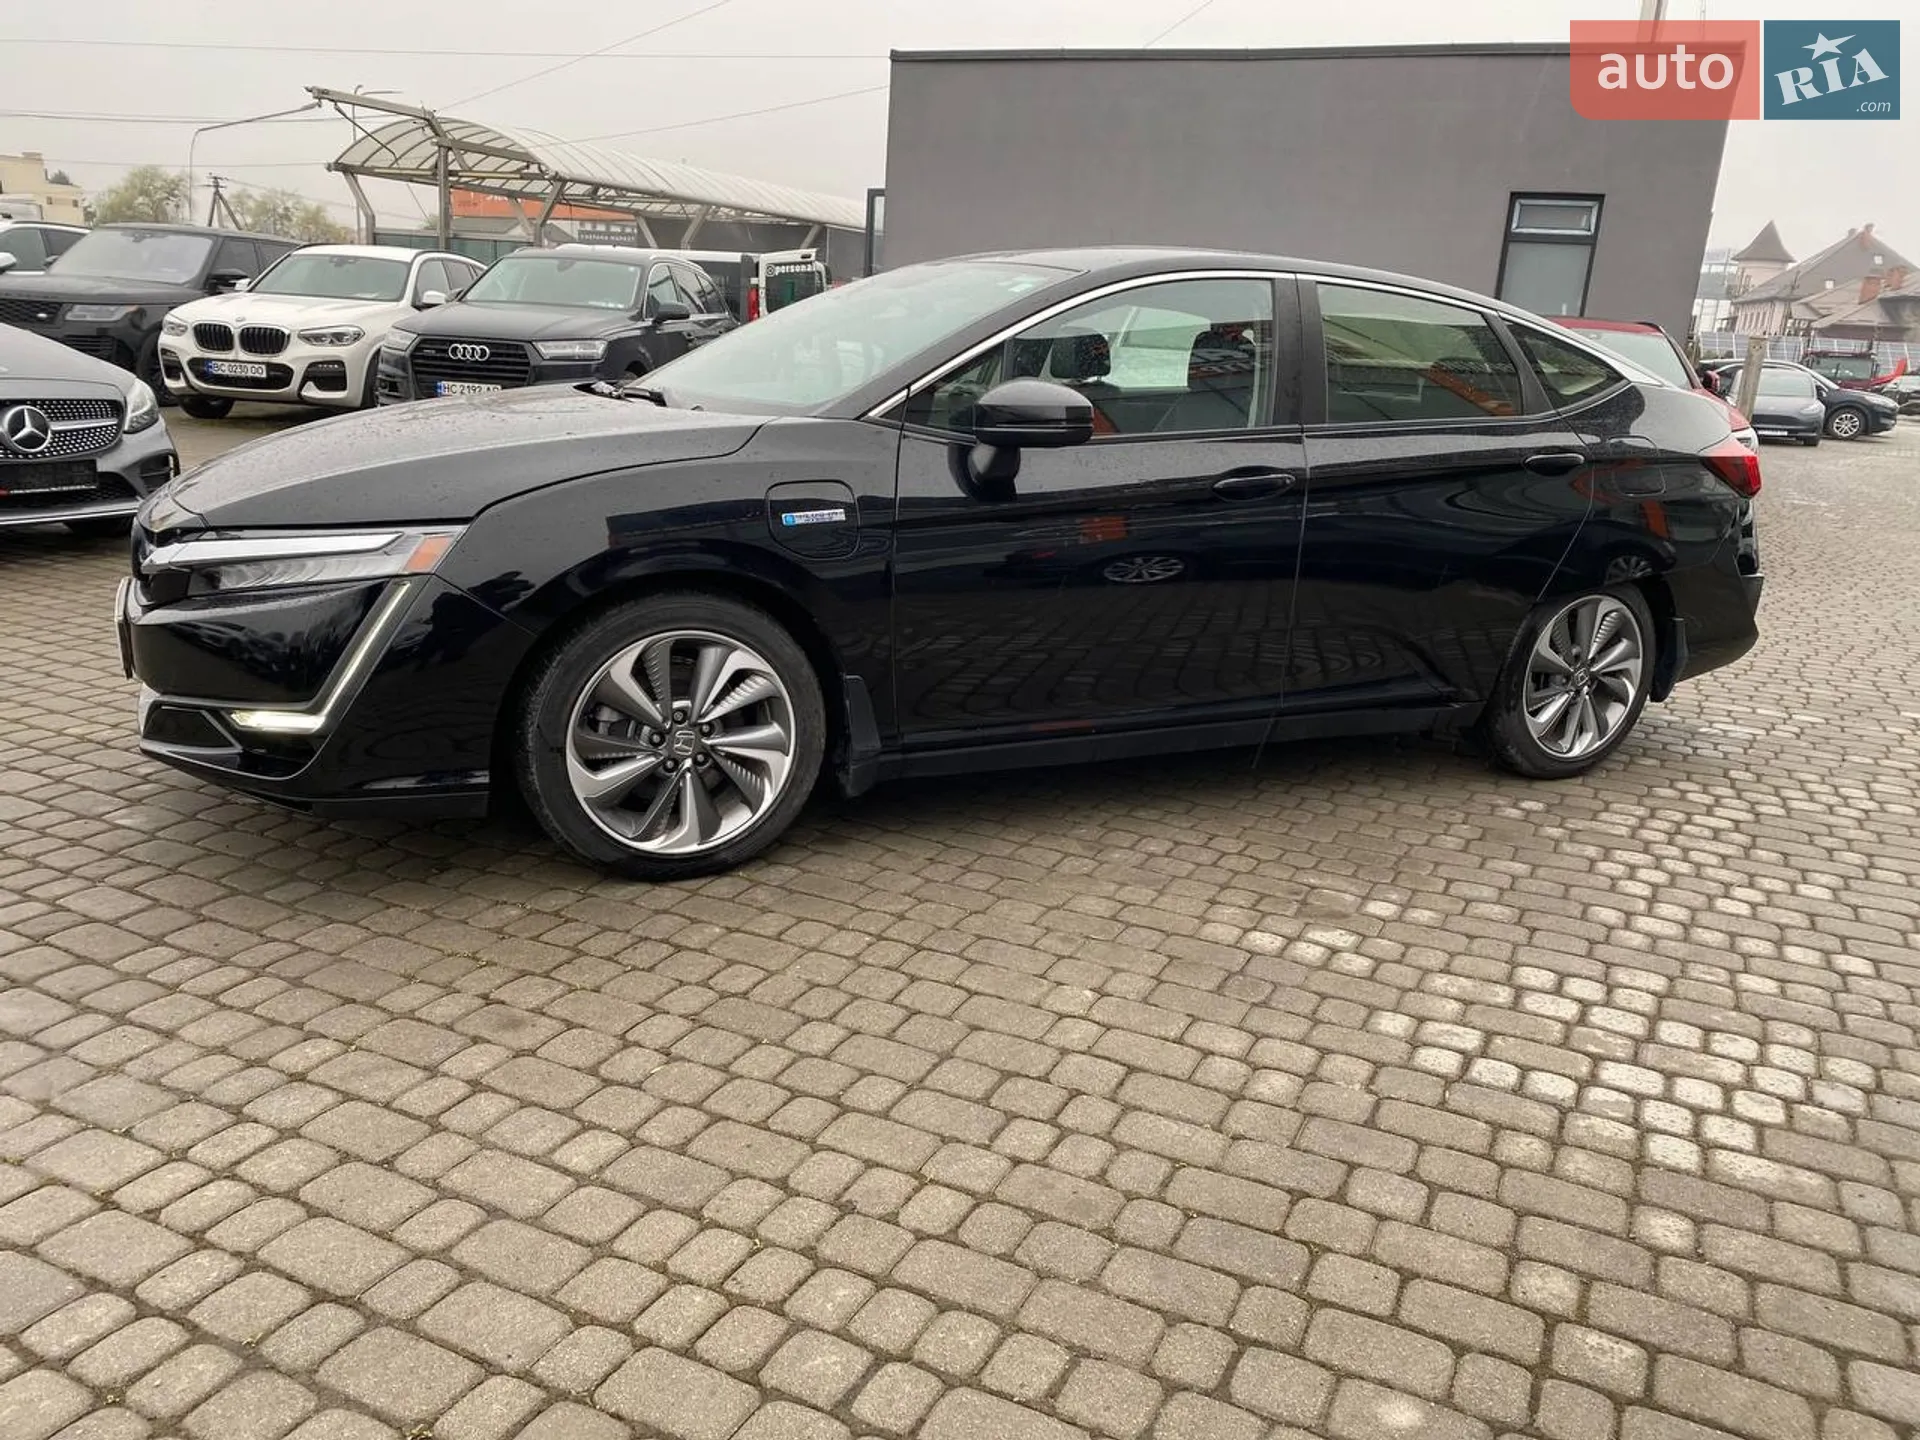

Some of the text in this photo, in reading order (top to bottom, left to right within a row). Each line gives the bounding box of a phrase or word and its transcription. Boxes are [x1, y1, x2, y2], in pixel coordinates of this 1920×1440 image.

[213, 363, 226, 373] BC
[228, 364, 248, 374] 0230
[443, 383, 457, 394] HC
[459, 384, 482, 395] 2192
